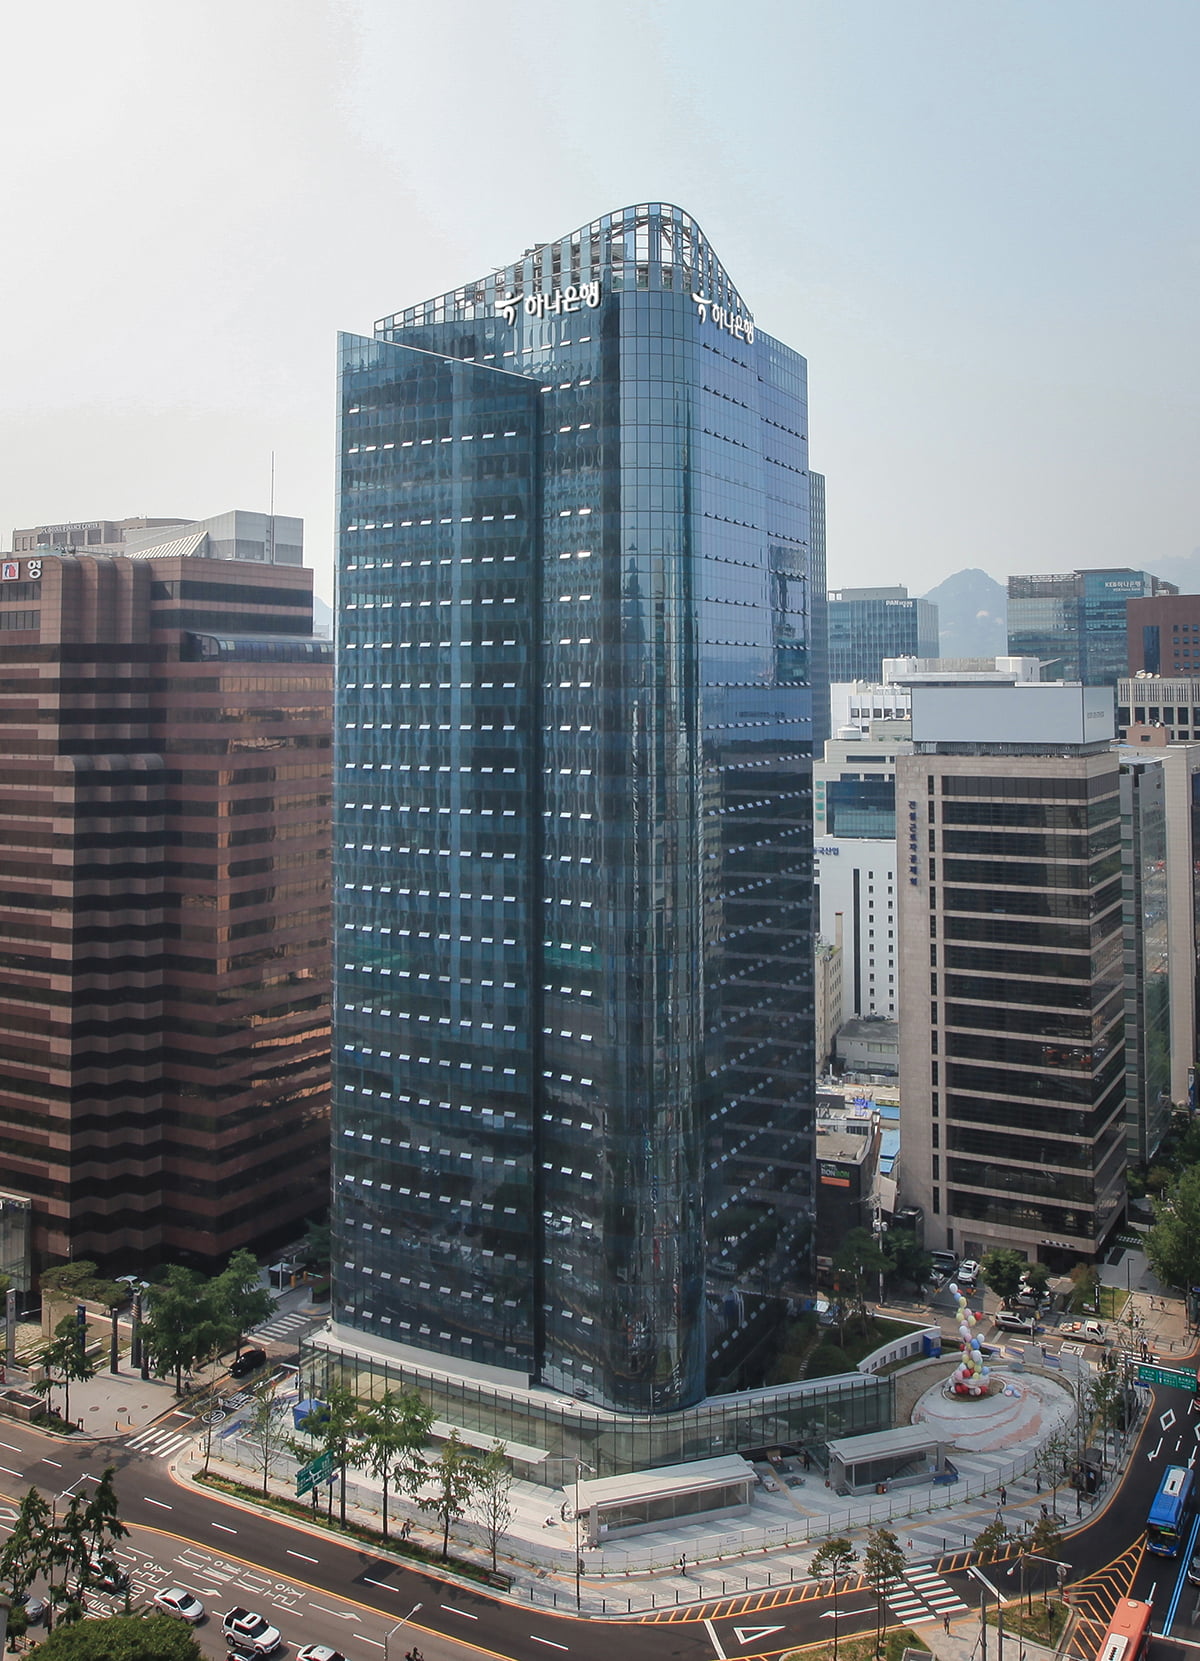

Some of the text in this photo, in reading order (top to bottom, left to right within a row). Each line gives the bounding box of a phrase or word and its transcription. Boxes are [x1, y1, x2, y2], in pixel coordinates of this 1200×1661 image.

[525, 281, 600, 317] 하나은행
[712, 303, 754, 344] 하나은행
[27, 560, 42, 579] 영
[263, 1583, 306, 1606] 종로
